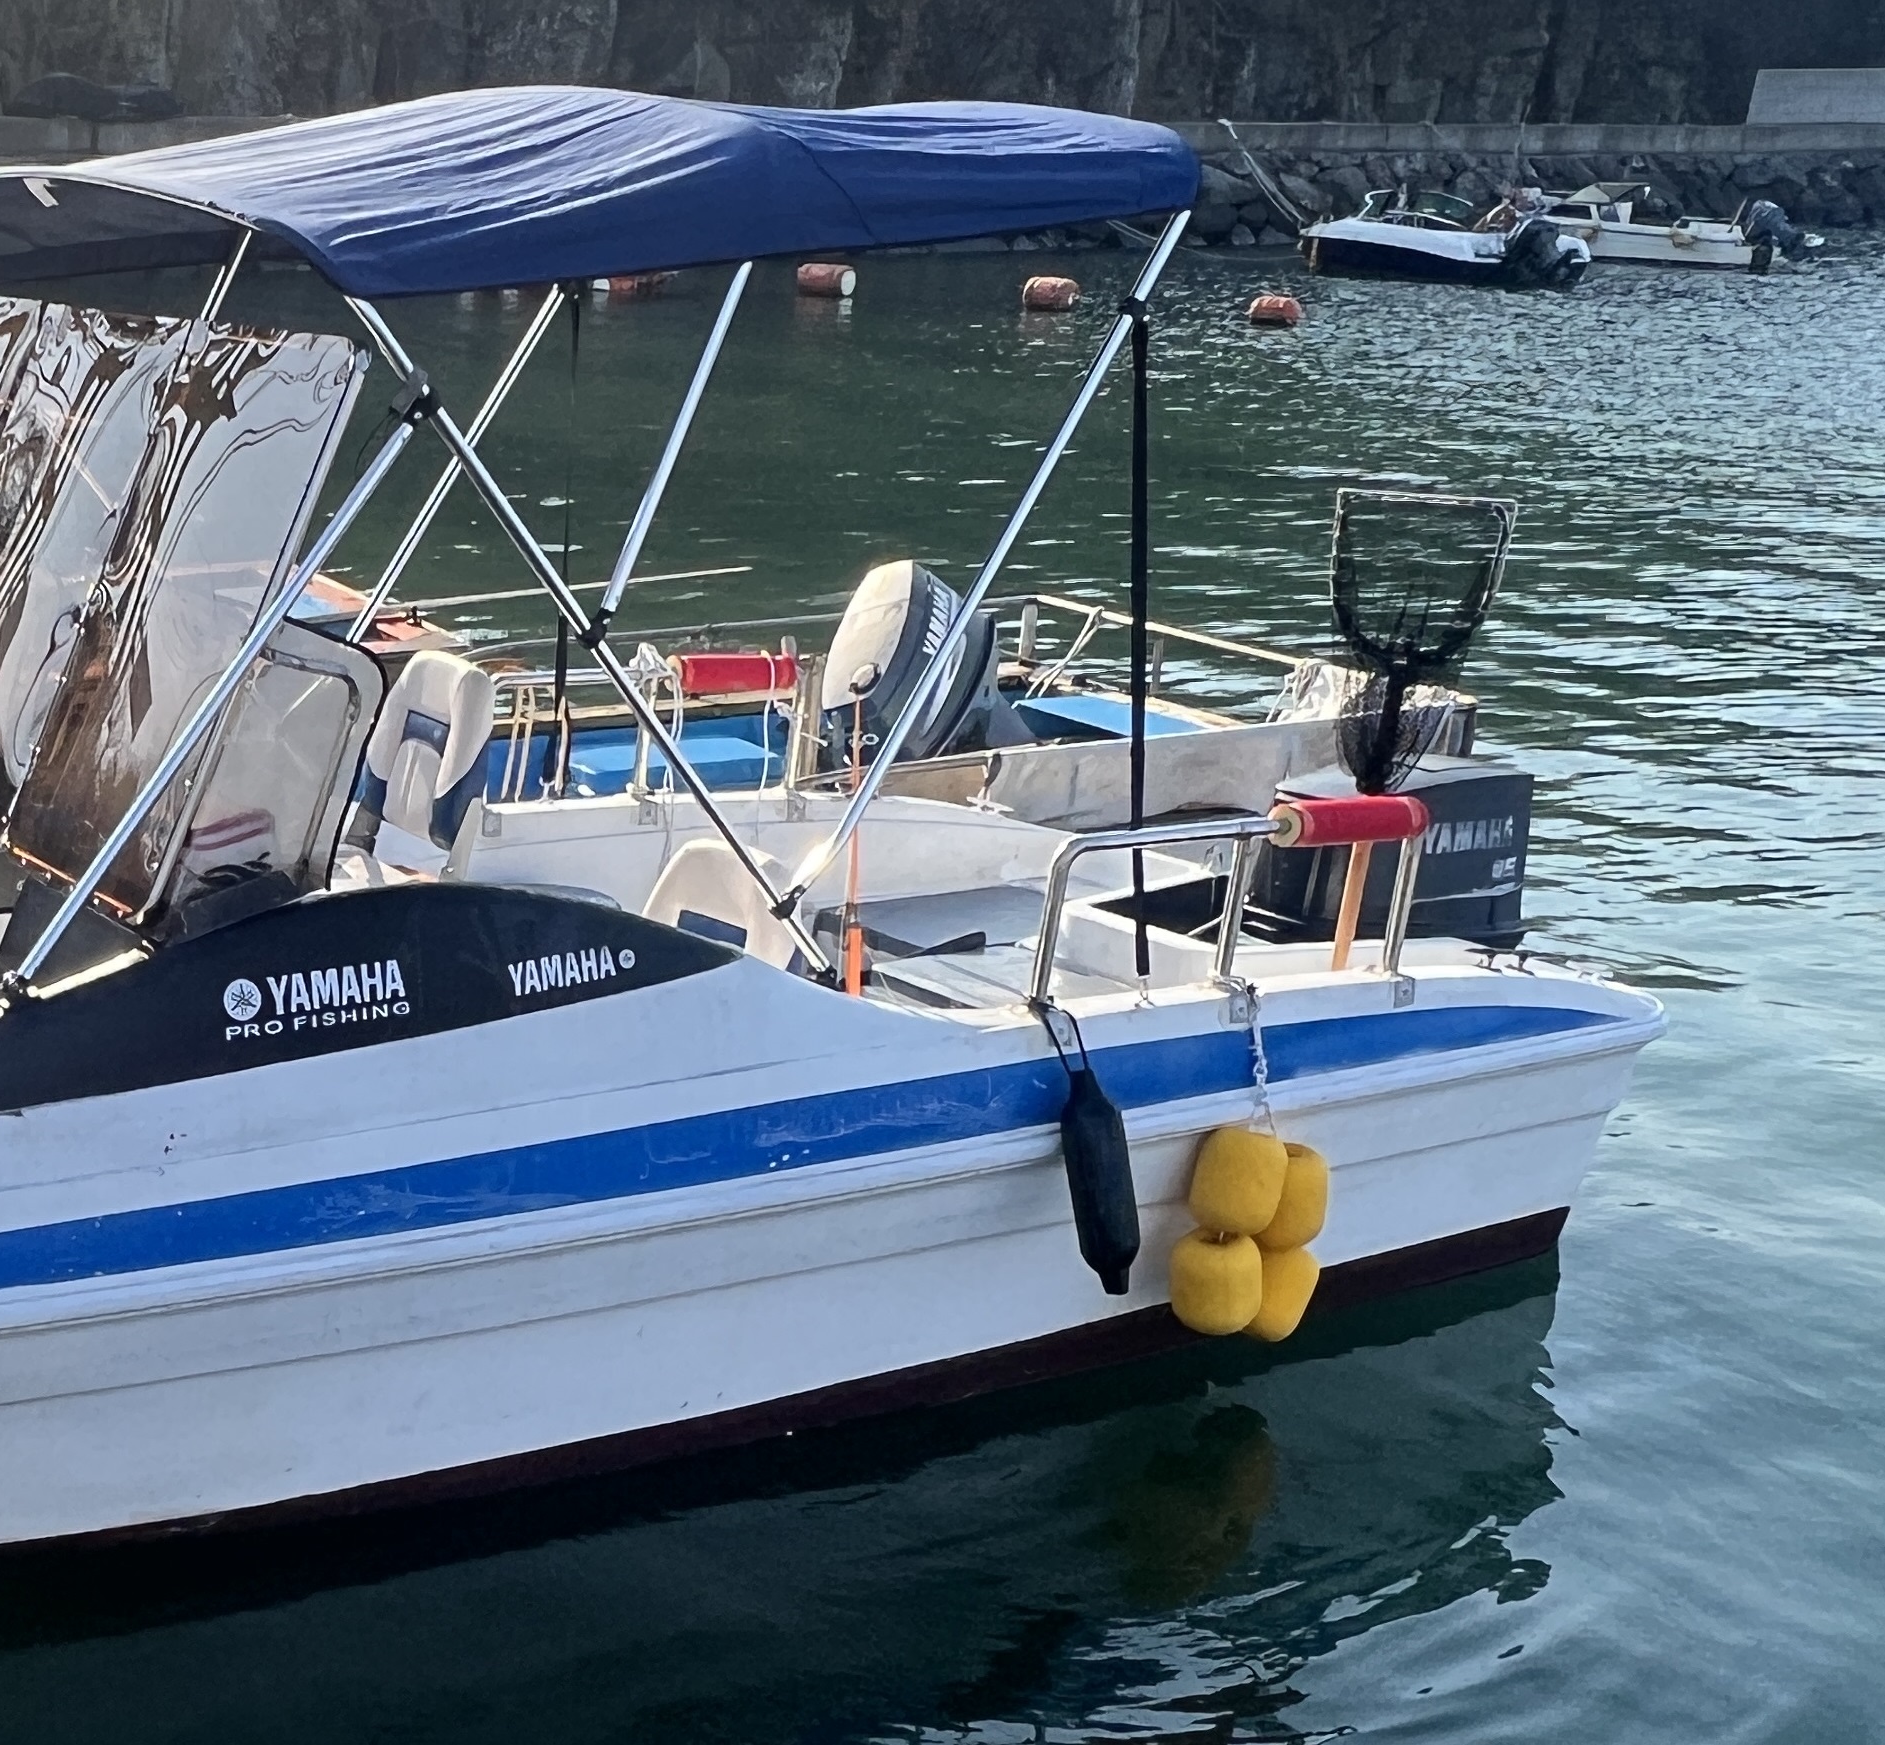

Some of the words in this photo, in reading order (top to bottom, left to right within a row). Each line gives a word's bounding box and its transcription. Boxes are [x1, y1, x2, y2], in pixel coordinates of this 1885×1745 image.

[266, 959, 406, 1015] YAMAHA
[508, 946, 616, 996] YAMAHA
[226, 1020, 283, 1041] PRO
[293, 1001, 410, 1031] FISHING
